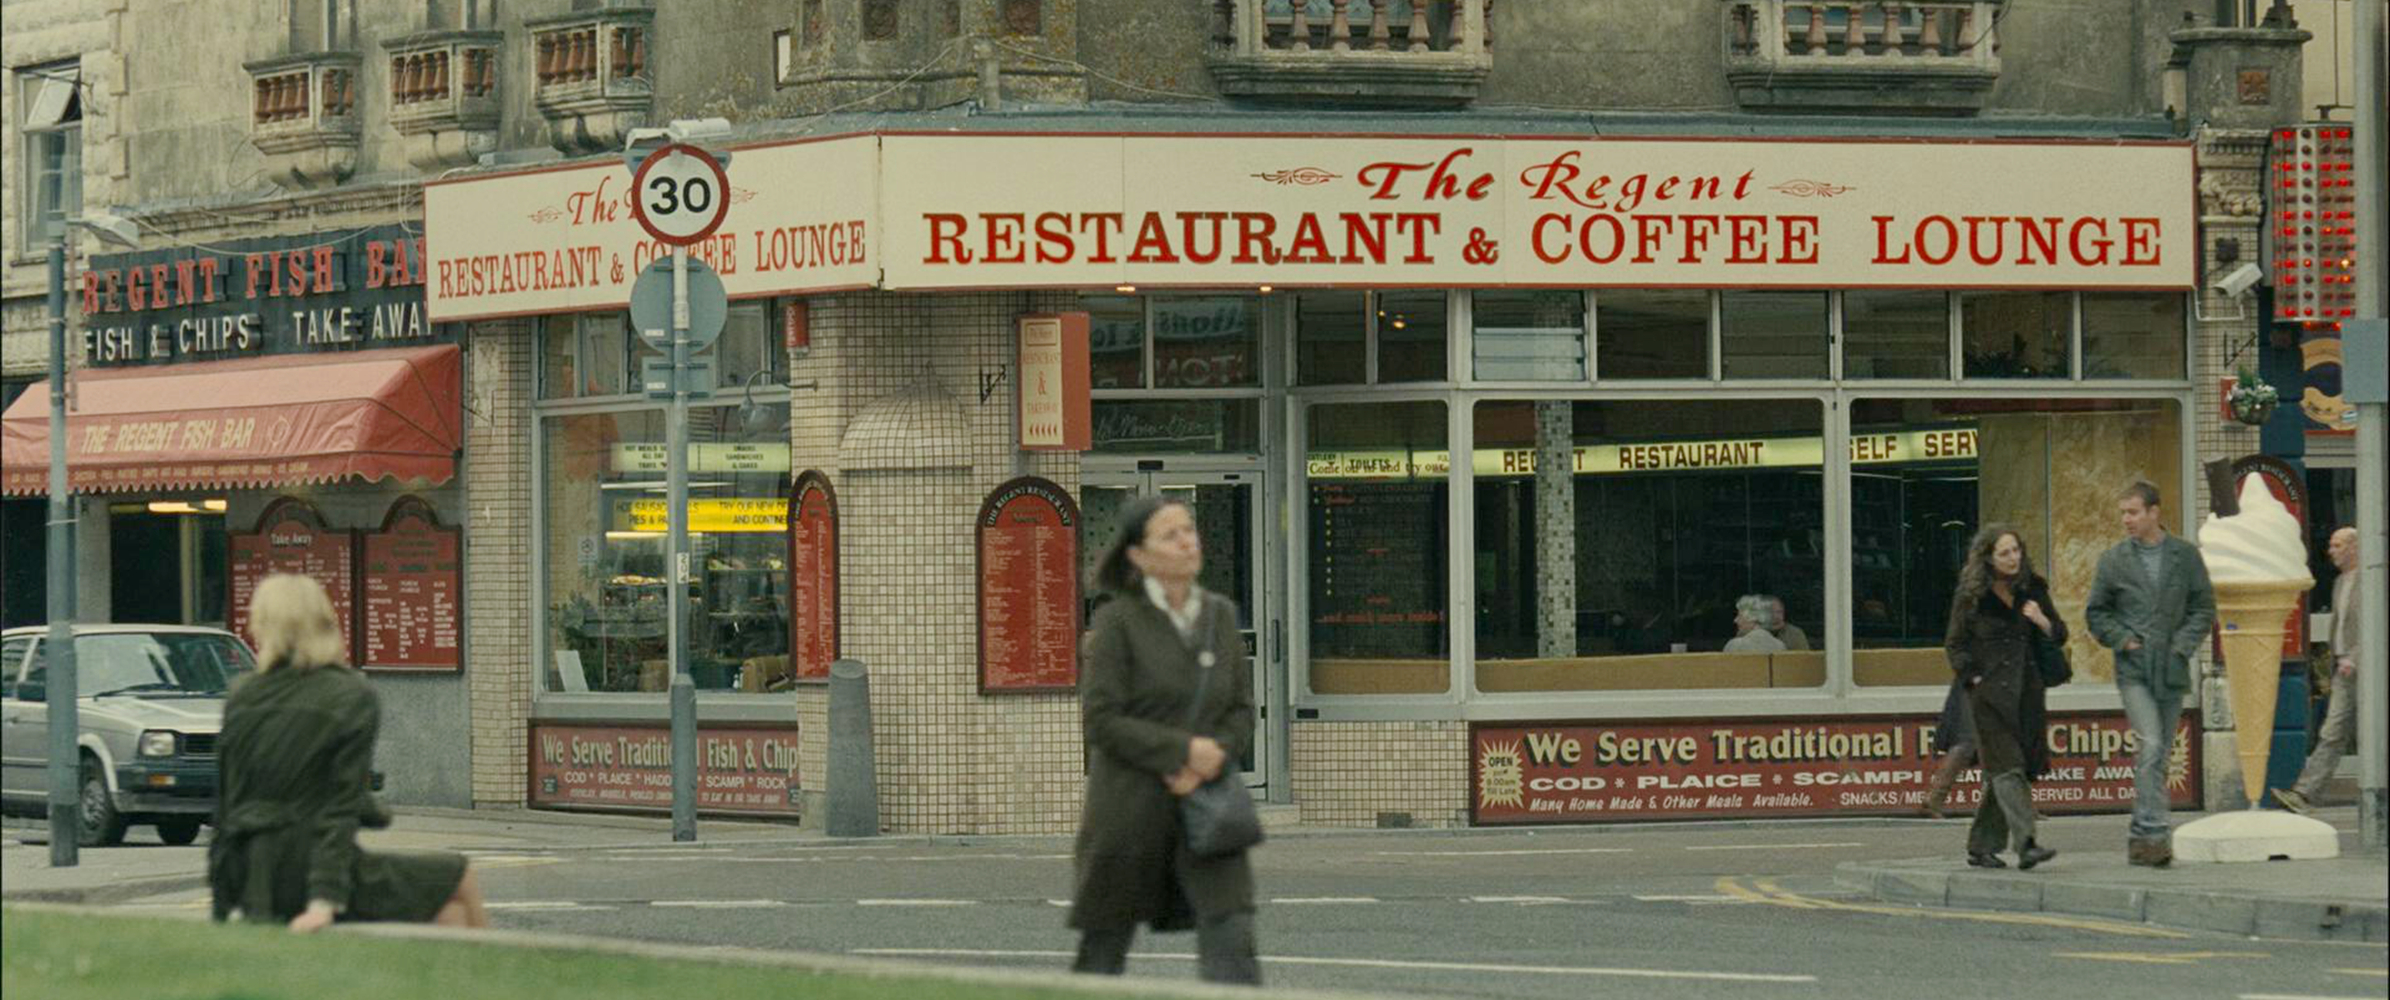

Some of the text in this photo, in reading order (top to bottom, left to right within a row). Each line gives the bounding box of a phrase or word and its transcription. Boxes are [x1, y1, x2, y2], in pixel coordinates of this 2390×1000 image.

[649, 176, 711, 215] 30
[1357, 148, 1755, 212] The Regent
[567, 175, 617, 225] The
[922, 211, 2162, 267] RESTAURANT & COFFEE LOUNGE
[438, 220, 867, 299] RESTAURANT & COEE LOUNGE
[81, 257, 218, 315] REGENT
[245, 245, 334, 298] FISH
[84, 327, 132, 361] FISH
[179, 314, 249, 354] CHIPS
[293, 307, 352, 345] TAKE
[81, 417, 256, 453] THE REGENT FISH BAR
[1924, 431, 1978, 457] SERV
[1503, 441, 1764, 473] RET RESTAURANT
[271, 532, 312, 545] Take Away
[542, 734, 798, 777] We Serve Traditil Fish & Chip
[1527, 732, 1581, 763] We
[1599, 731, 1698, 762] Serve
[1712, 727, 1902, 761] Traditional
[2047, 723, 2139, 762] Chips
[1488, 756, 1513, 767] OPEN
[2036, 767, 2085, 780] AKE
[2092, 766, 2138, 780] AWA
[564, 771, 587, 784] COD
[598, 773, 633, 785] PLAICE
[644, 775, 672, 787] HADD
[706, 776, 745, 788] SCAMPI
[756, 778, 786, 789] ROCK
[1529, 771, 1922, 791] COD PLAICE SCAMPI
[1956, 789, 1966, 803] &
[2031, 786, 2137, 802] SERVED ALL DA
[1529, 798, 1564, 814] Many
[1569, 797, 1604, 811] Home
[1610, 796, 1643, 810] Made
[1663, 795, 1700, 809] Other
[1706, 794, 1742, 808] Meals
